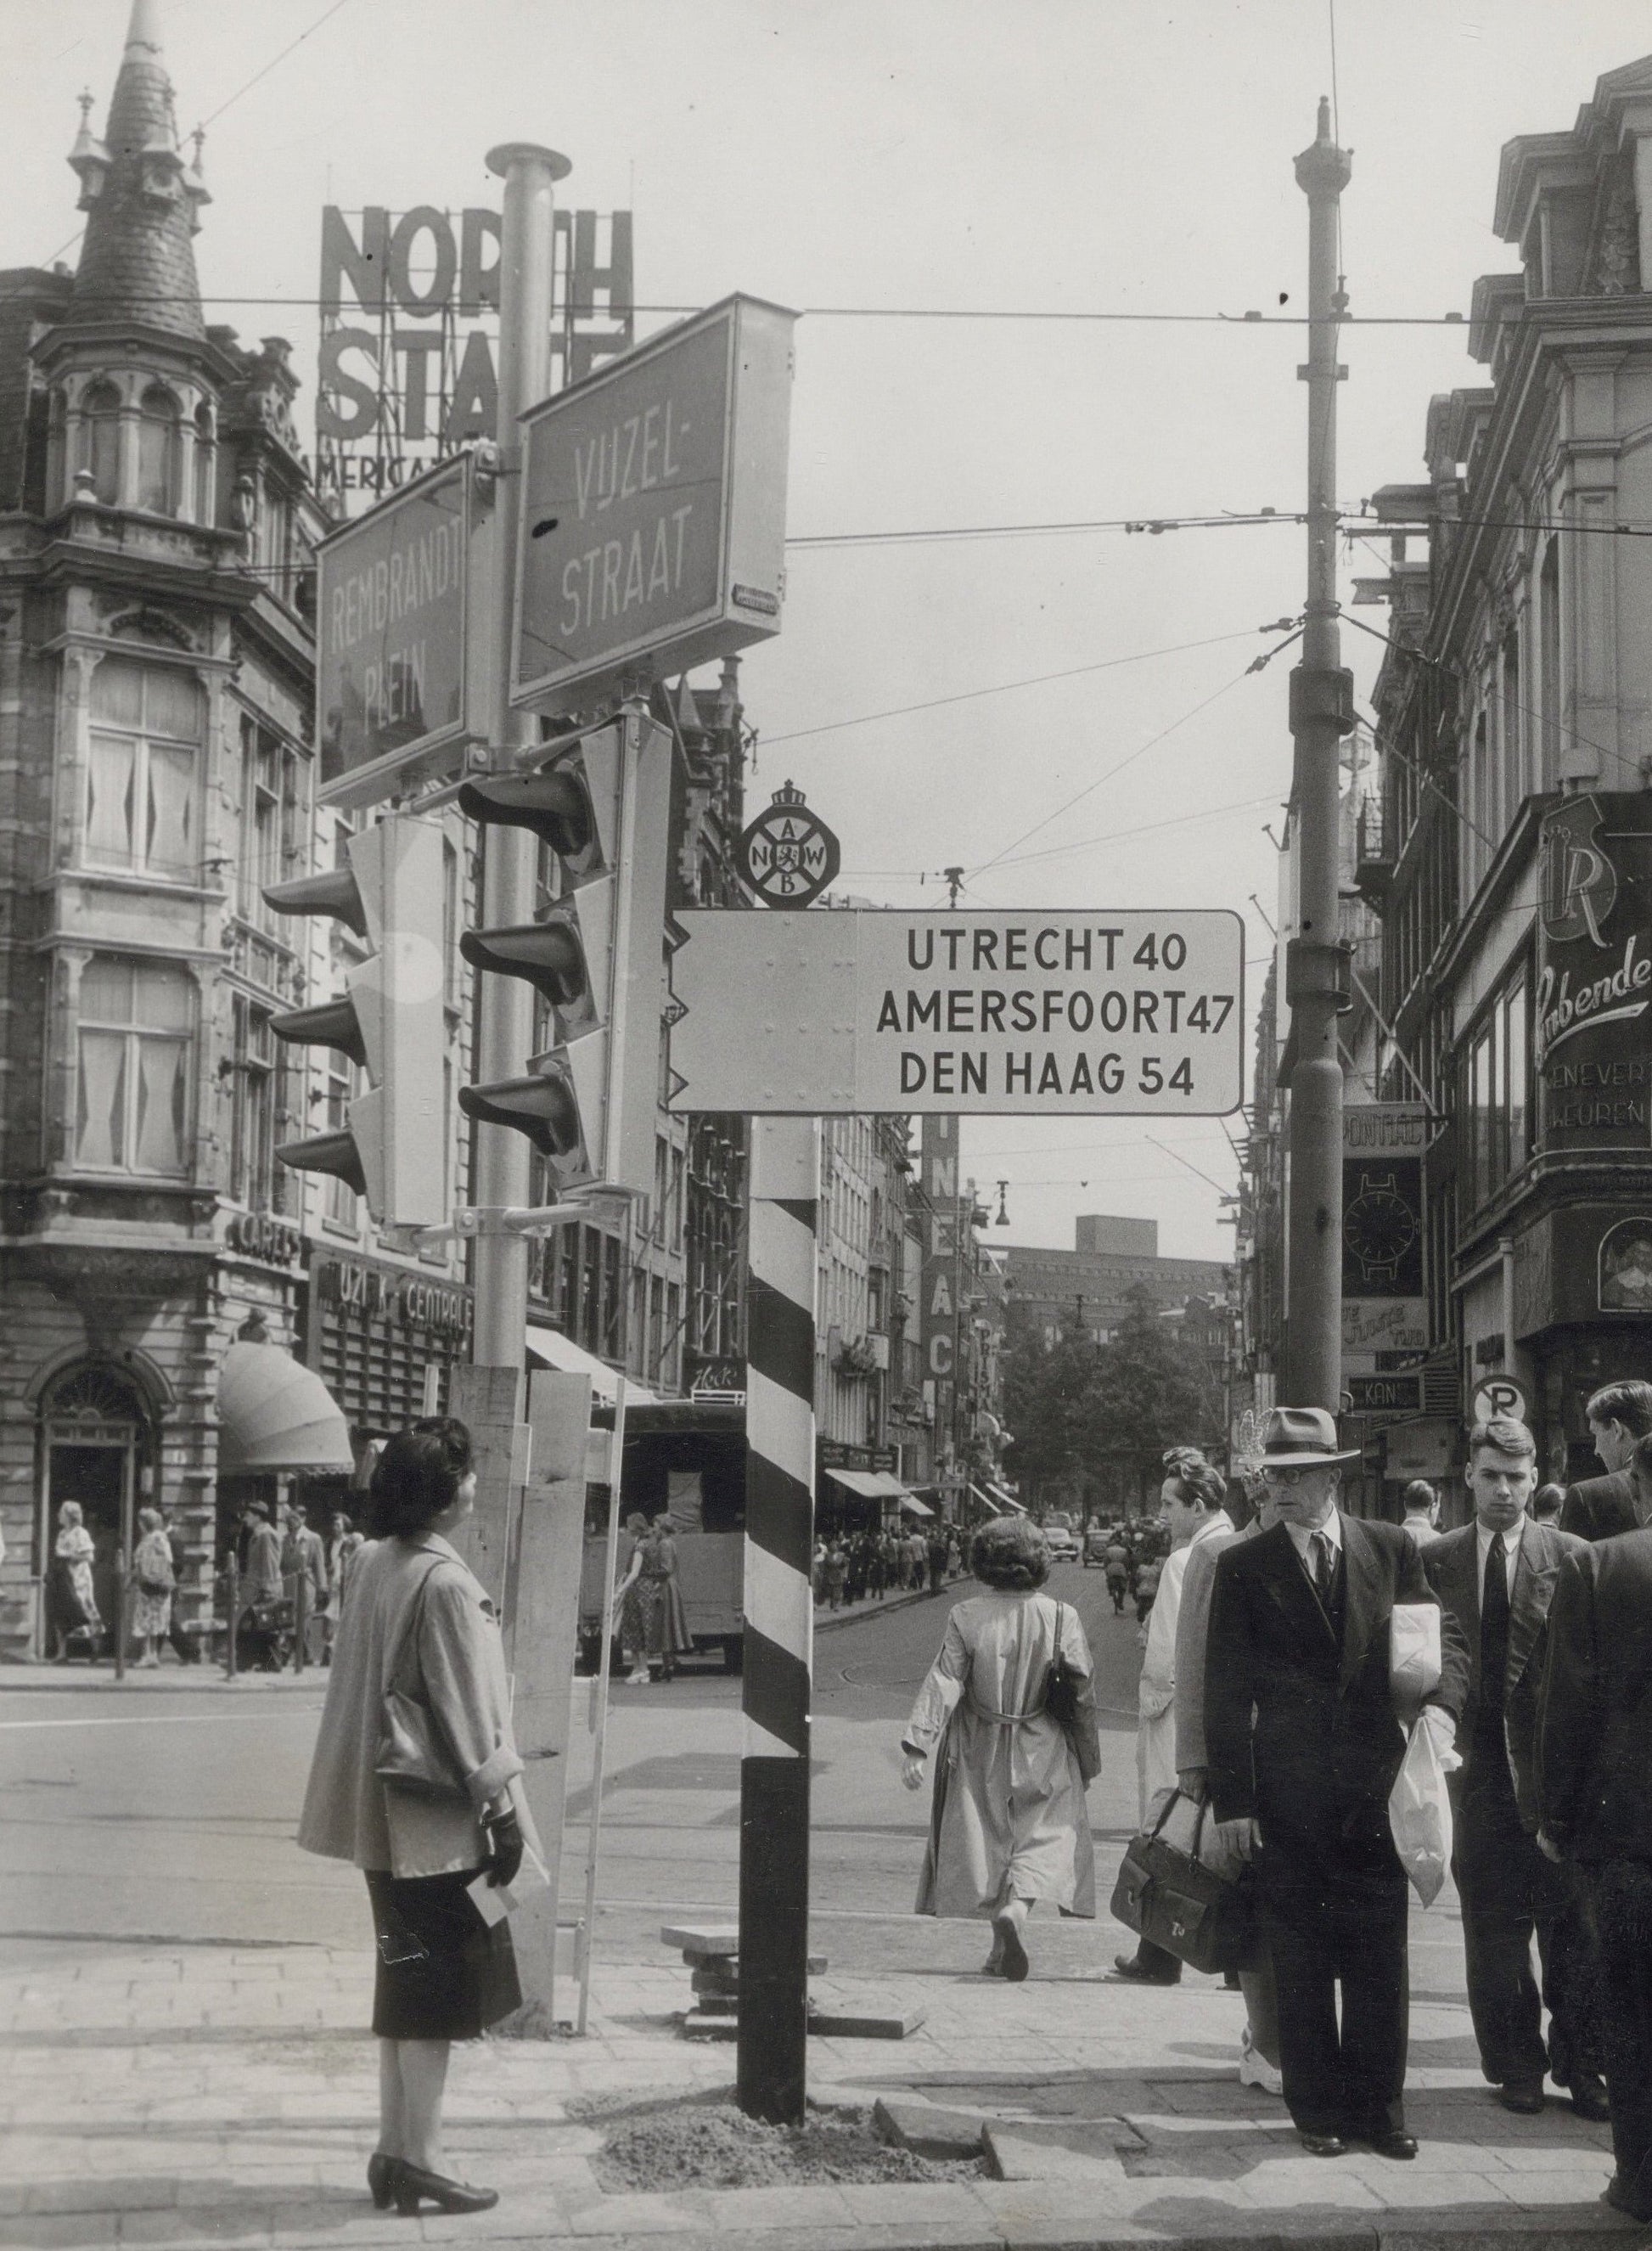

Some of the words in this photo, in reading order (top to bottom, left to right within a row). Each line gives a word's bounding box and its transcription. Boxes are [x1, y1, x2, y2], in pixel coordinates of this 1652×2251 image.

[319, 205, 632, 318] NORH
[576, 400, 689, 519] VIJZEL-
[331, 515, 461, 655] REMBRANDT
[560, 504, 693, 636] STRAAT
[365, 639, 426, 735] PLEIN
[907, 928, 1124, 971] UTRECHT
[1132, 932, 1187, 971] 40
[876, 990, 1187, 1033] AMERSFOORT
[1187, 995, 1234, 1033] 47
[900, 1052, 987, 1095] DEN
[1005, 1052, 1125, 1095] HAAG
[1138, 1056, 1194, 1095] 54
